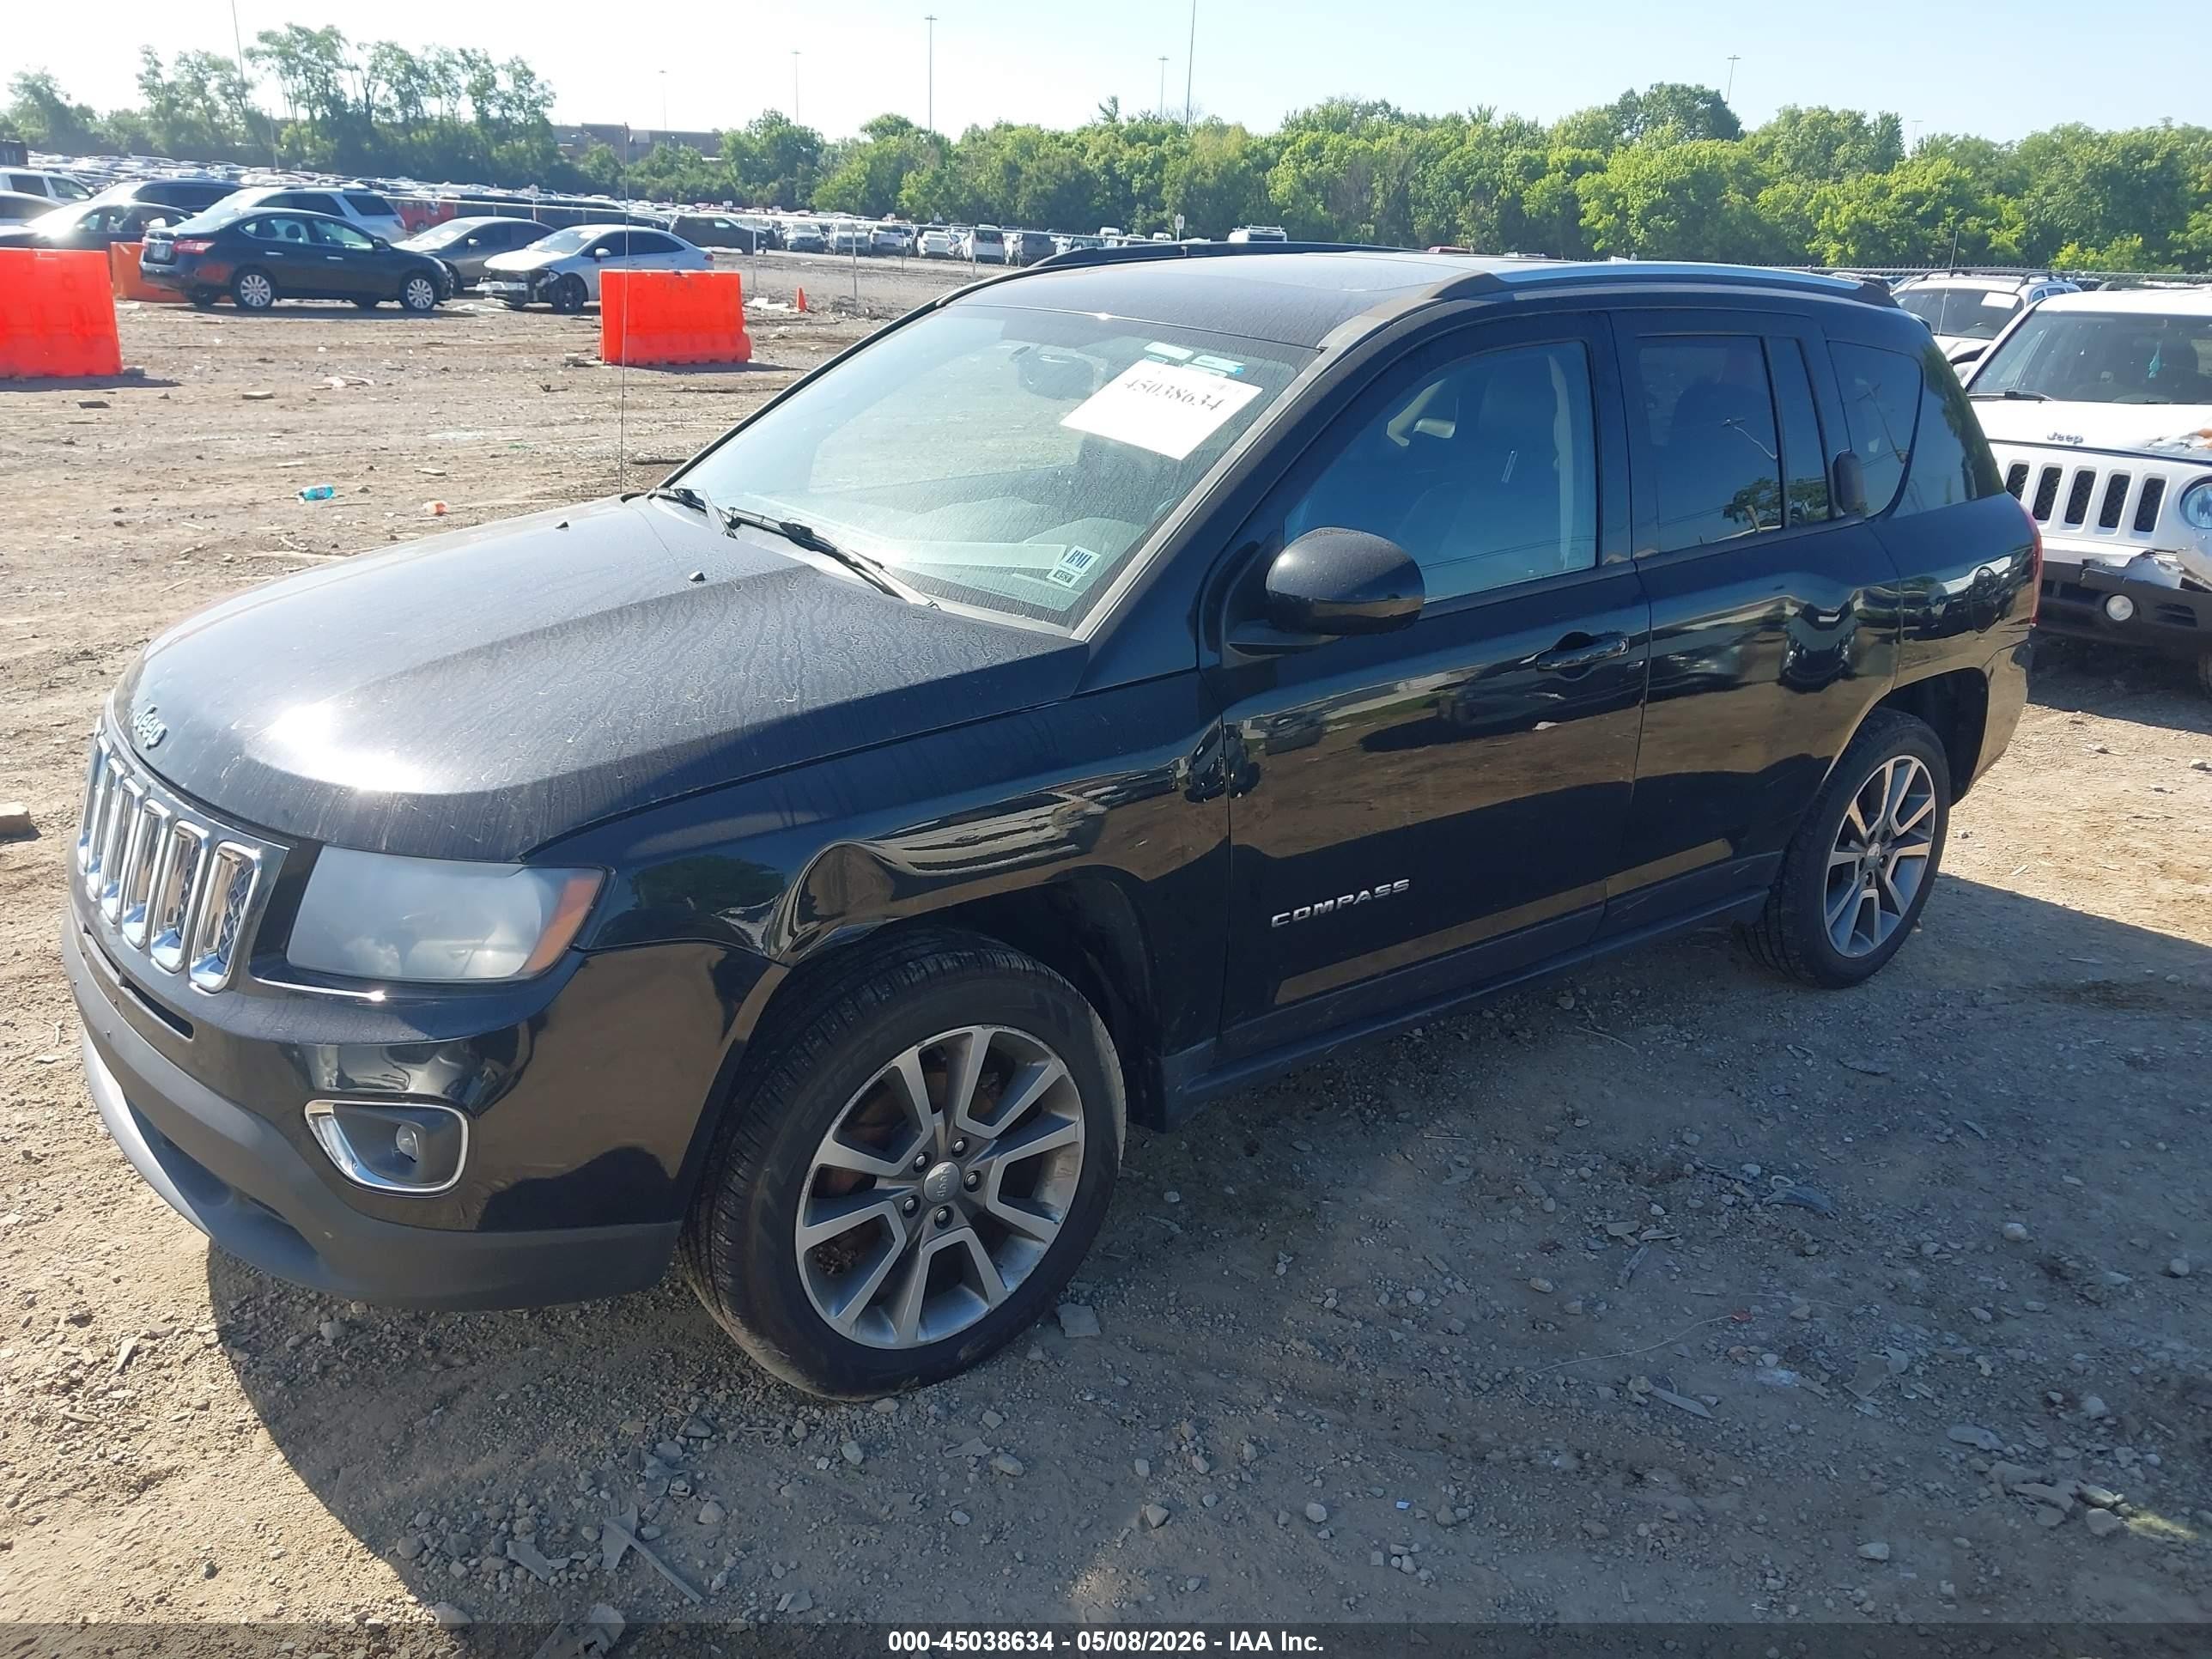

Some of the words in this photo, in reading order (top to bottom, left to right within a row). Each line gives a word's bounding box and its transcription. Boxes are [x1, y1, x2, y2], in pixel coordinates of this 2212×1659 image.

[1125, 379, 1224, 411] 45038634
[2046, 431, 2083, 445] Jeep
[133, 704, 167, 748] Jeep
[1271, 878, 1410, 928] COMPASS
[936, 1166, 950, 1198] Jeep
